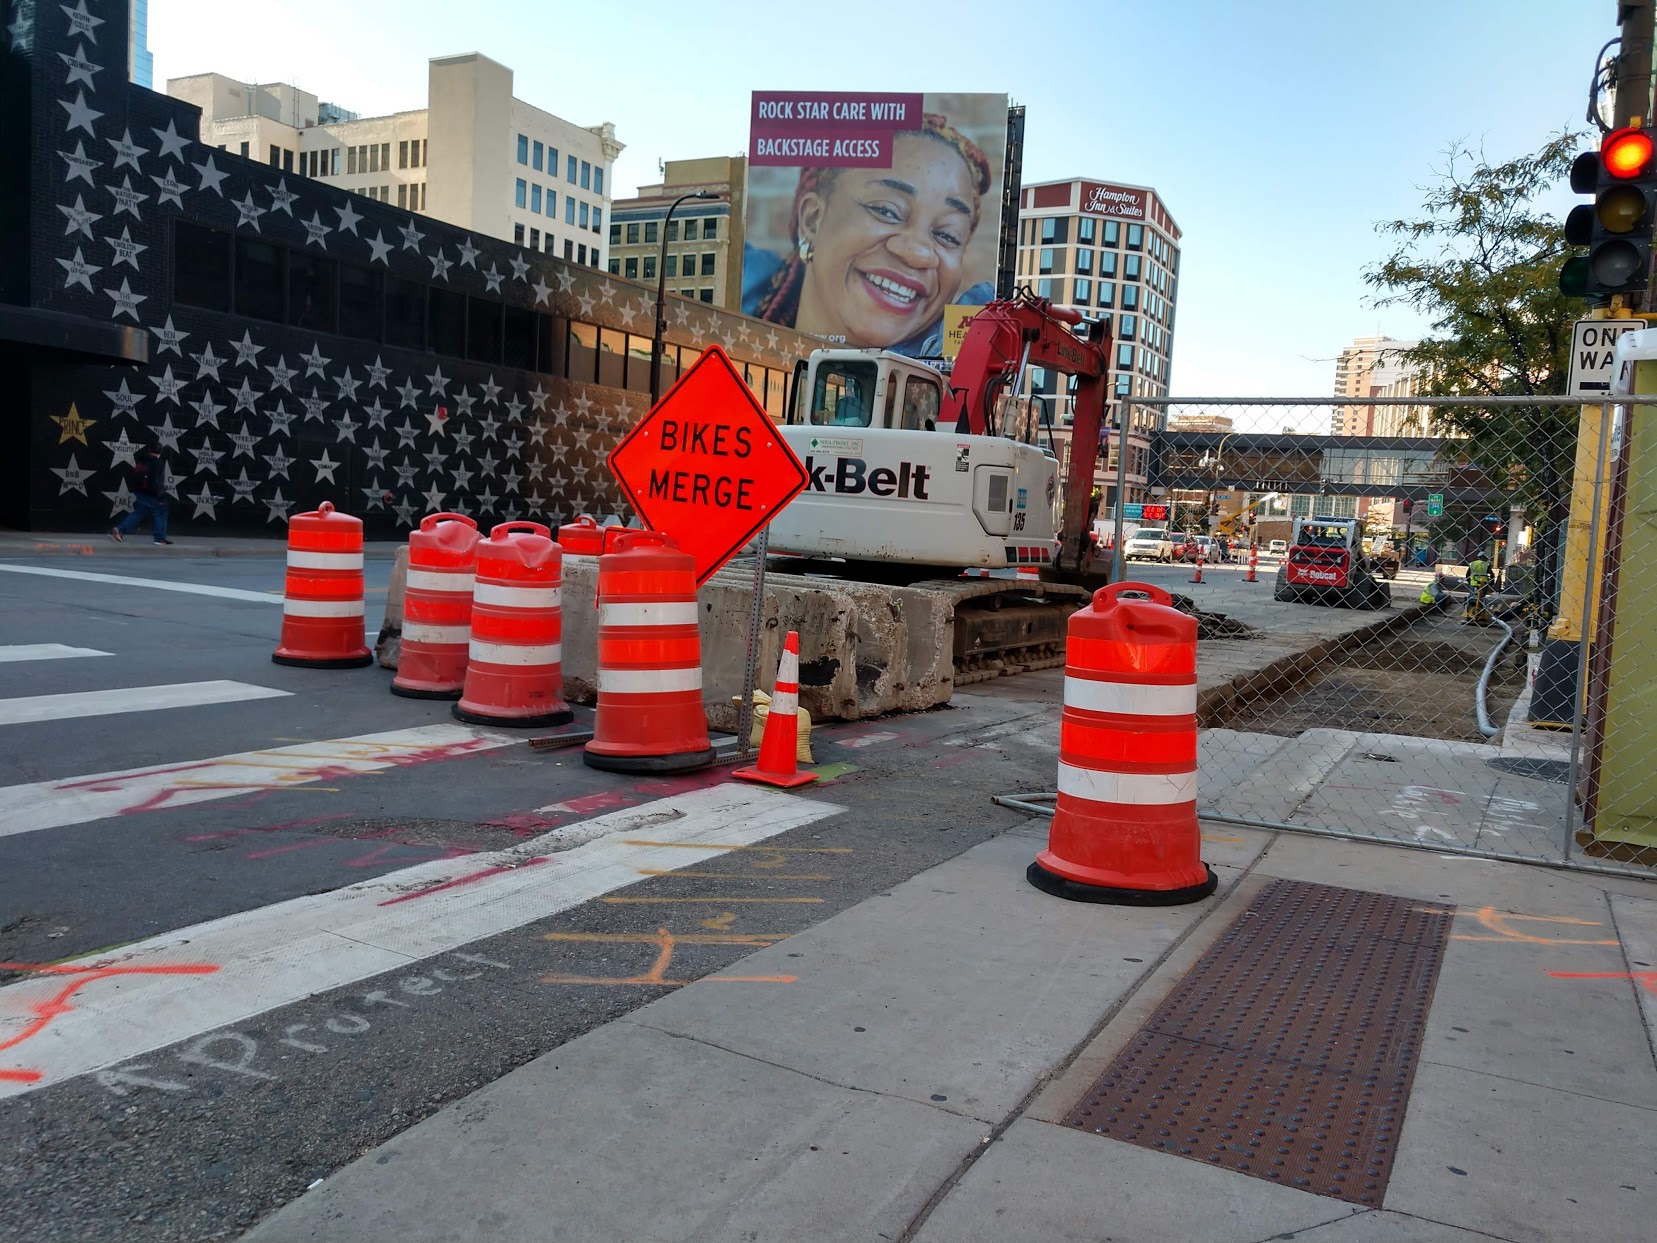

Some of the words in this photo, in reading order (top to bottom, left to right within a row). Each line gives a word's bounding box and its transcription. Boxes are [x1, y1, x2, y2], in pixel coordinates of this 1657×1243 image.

[758, 101, 793, 119] ROCK
[797, 101, 829, 120] STAR
[833, 102, 867, 120] CARE
[870, 103, 906, 121] WITH
[757, 138, 830, 157] BACKSTAGE
[833, 139, 880, 158] ACCESS
[1089, 187, 1140, 205] Hampton
[118, 198, 137, 208] PARTY
[1085, 200, 1110, 213] Inn
[1116, 203, 1142, 217] Suites
[114, 240, 137, 251] ENGLISH
[119, 248, 133, 258] BEAT
[163, 330, 175, 339] BEN
[1582, 327, 1635, 347] ON
[1580, 351, 1614, 370] WA
[115, 393, 133, 402] SOUL
[59, 417, 87, 436] PRINCE
[153, 426, 182, 438] NIRVANA
[660, 420, 752, 458] BIKES
[237, 443, 250, 451] HILL
[65, 470, 80, 478] BOB
[649, 468, 754, 511] MERGE
[114, 496, 132, 508] CAKE
[197, 497, 215, 505] INXS
[1013, 512, 1026, 531] 135
[1309, 570, 1337, 580] Bobcat
